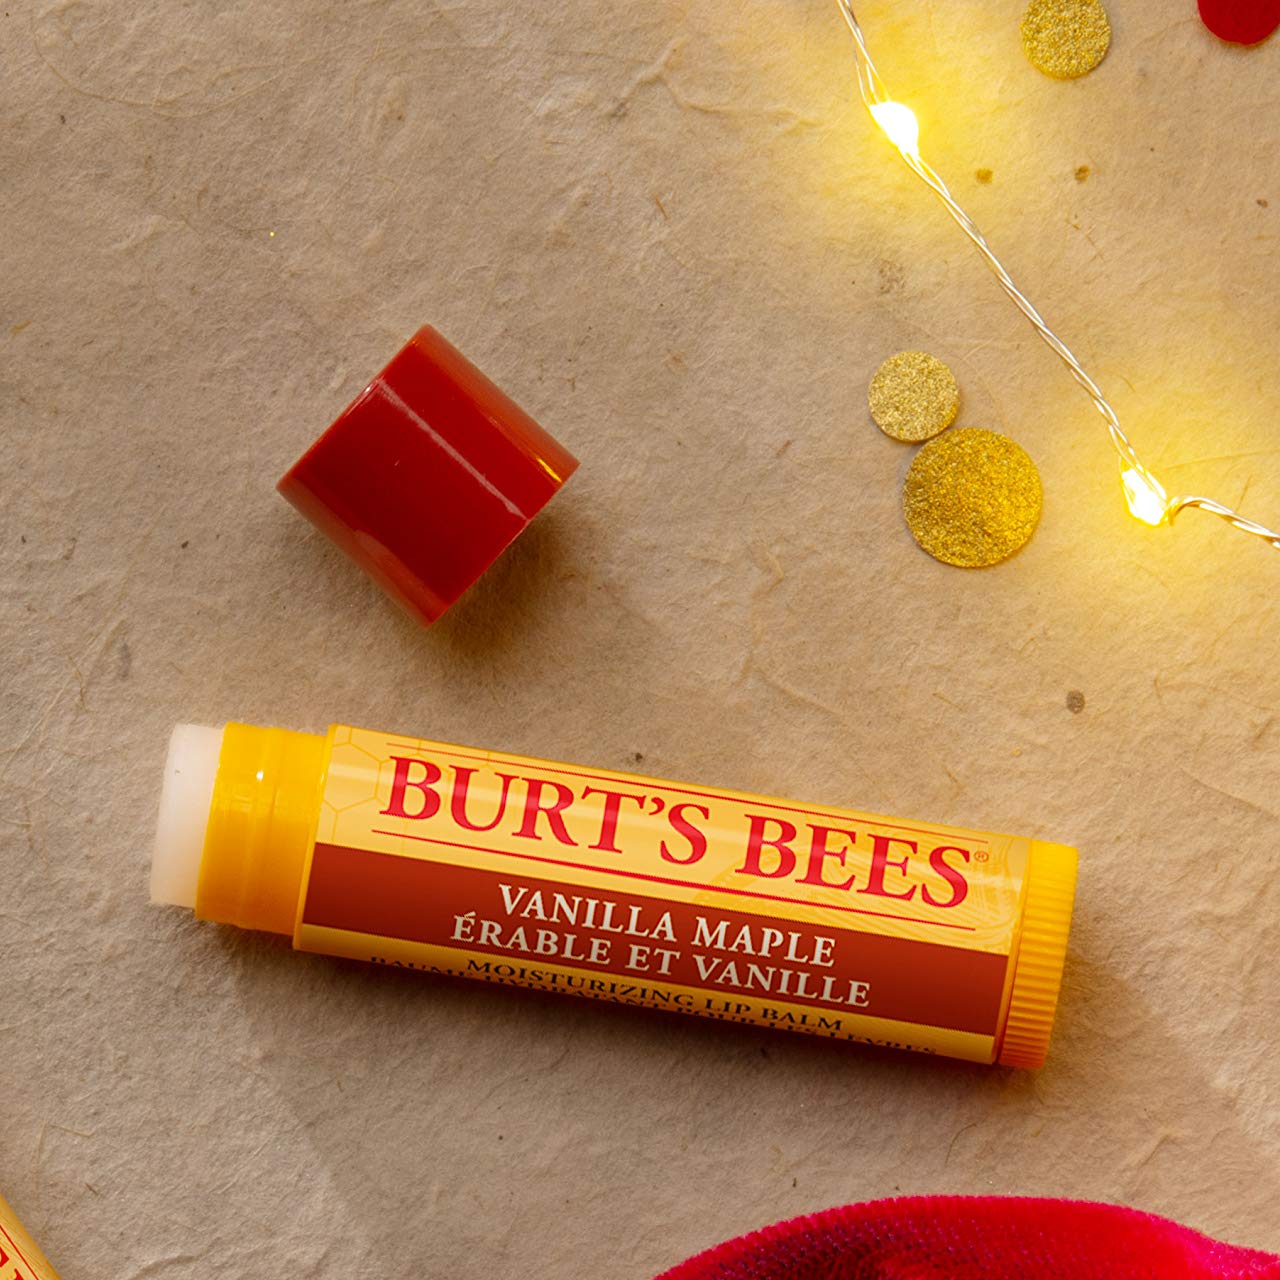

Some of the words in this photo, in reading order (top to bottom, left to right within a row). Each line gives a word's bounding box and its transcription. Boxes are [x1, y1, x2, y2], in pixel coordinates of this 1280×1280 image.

[379, 755, 710, 865] BURT'S
[451, 911, 611, 965] ÉRABLE
[627, 944, 679, 974] ET
[692, 954, 870, 1007] VANILLE
[499, 884, 677, 942] VANILLA
[691, 916, 836, 967] MAPLE
[466, 959, 694, 1006] MOISTURIZING
[705, 998, 751, 1014] LIP
[761, 1008, 843, 1031] BALM
